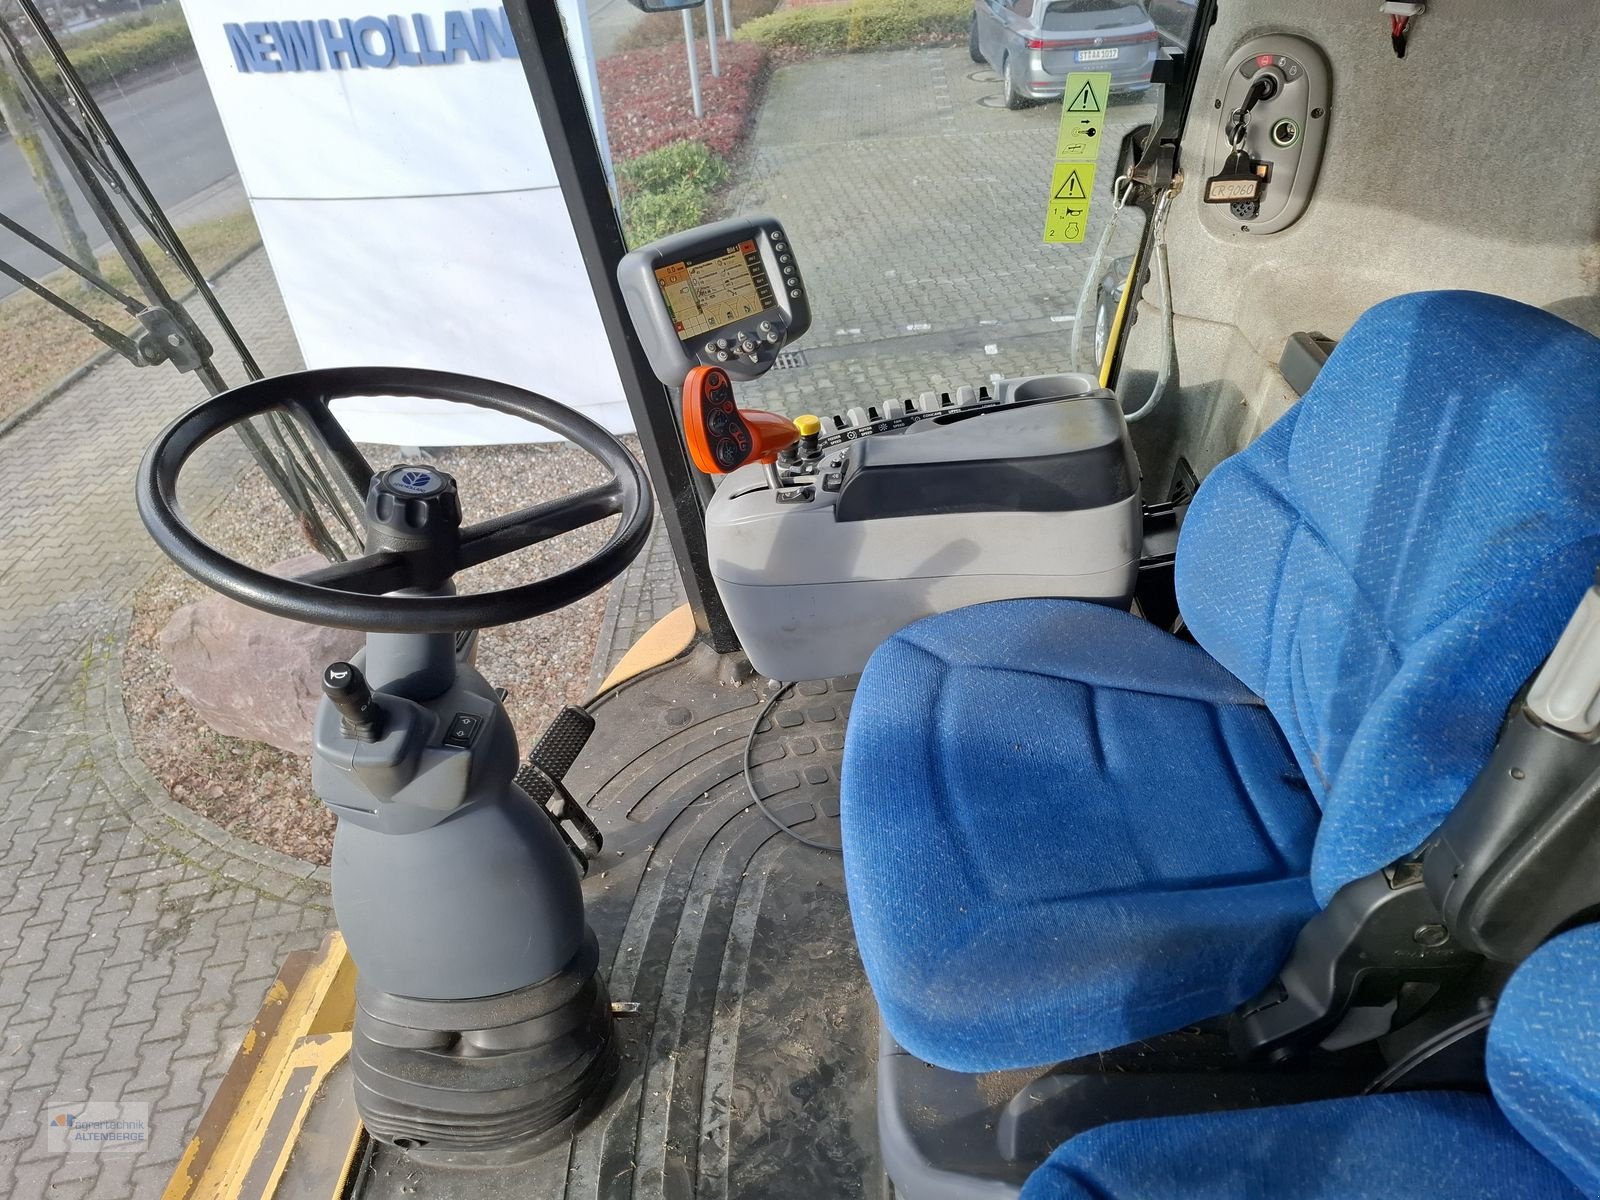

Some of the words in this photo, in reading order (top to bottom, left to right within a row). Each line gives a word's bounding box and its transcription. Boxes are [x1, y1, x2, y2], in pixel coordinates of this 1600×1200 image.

[223, 20, 322, 73] NEW
[318, 7, 519, 70] HOLLAN
[1211, 184, 1226, 197] CR
[1227, 183, 1255, 196] 9060
